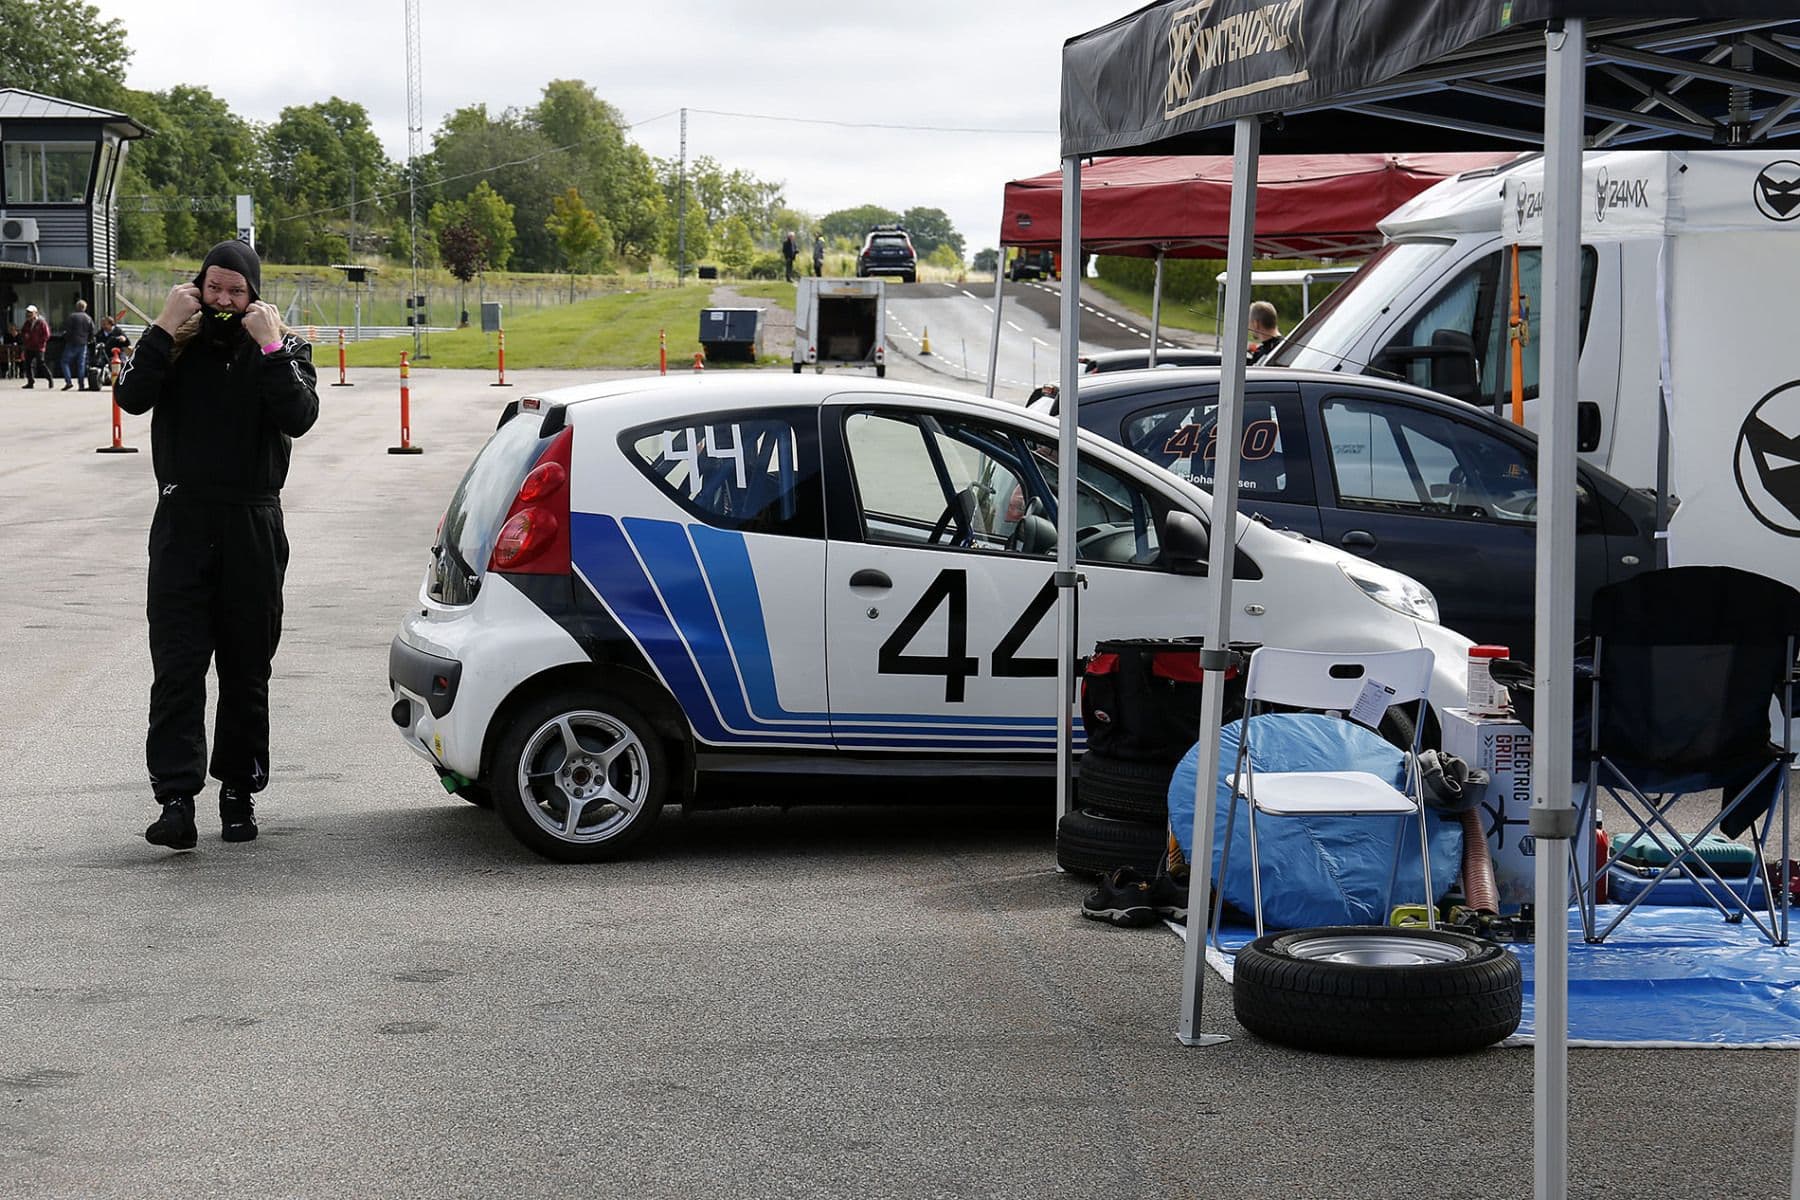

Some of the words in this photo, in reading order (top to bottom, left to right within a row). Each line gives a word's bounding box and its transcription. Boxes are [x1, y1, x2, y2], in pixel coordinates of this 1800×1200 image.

[1608, 179, 1649, 208] 24MX
[664, 424, 747, 501] 44
[878, 568, 1087, 704] 44
[1495, 734, 1513, 774] GRILL
[1513, 734, 1531, 802] ELECTRIC
